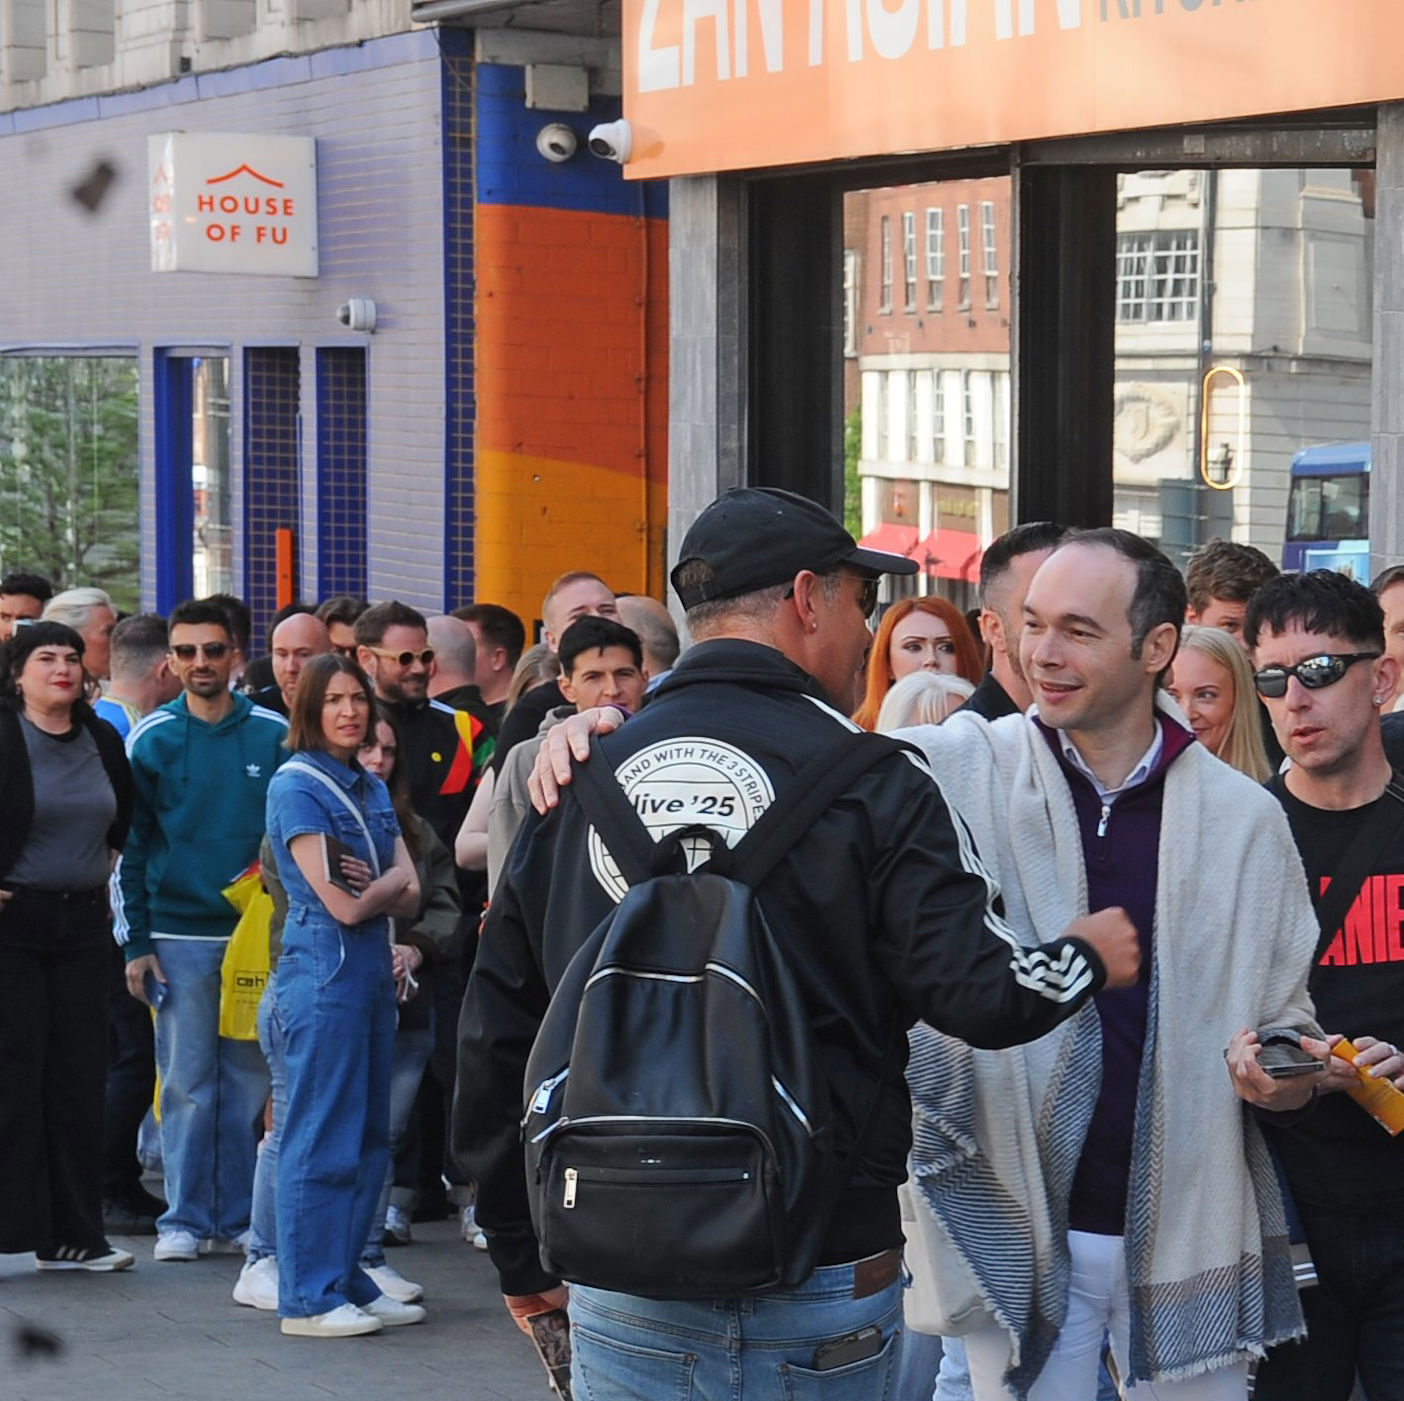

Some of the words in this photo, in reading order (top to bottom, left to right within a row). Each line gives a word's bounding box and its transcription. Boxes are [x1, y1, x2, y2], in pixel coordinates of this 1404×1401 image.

[197, 195, 294, 216] HOUSE
[206, 224, 241, 243] OF
[256, 226, 288, 244] FU
[654, 747, 694, 764] WITH
[699, 748, 729, 765] THE
[726, 761, 737, 771] 3
[734, 767, 765, 822] STRIPE
